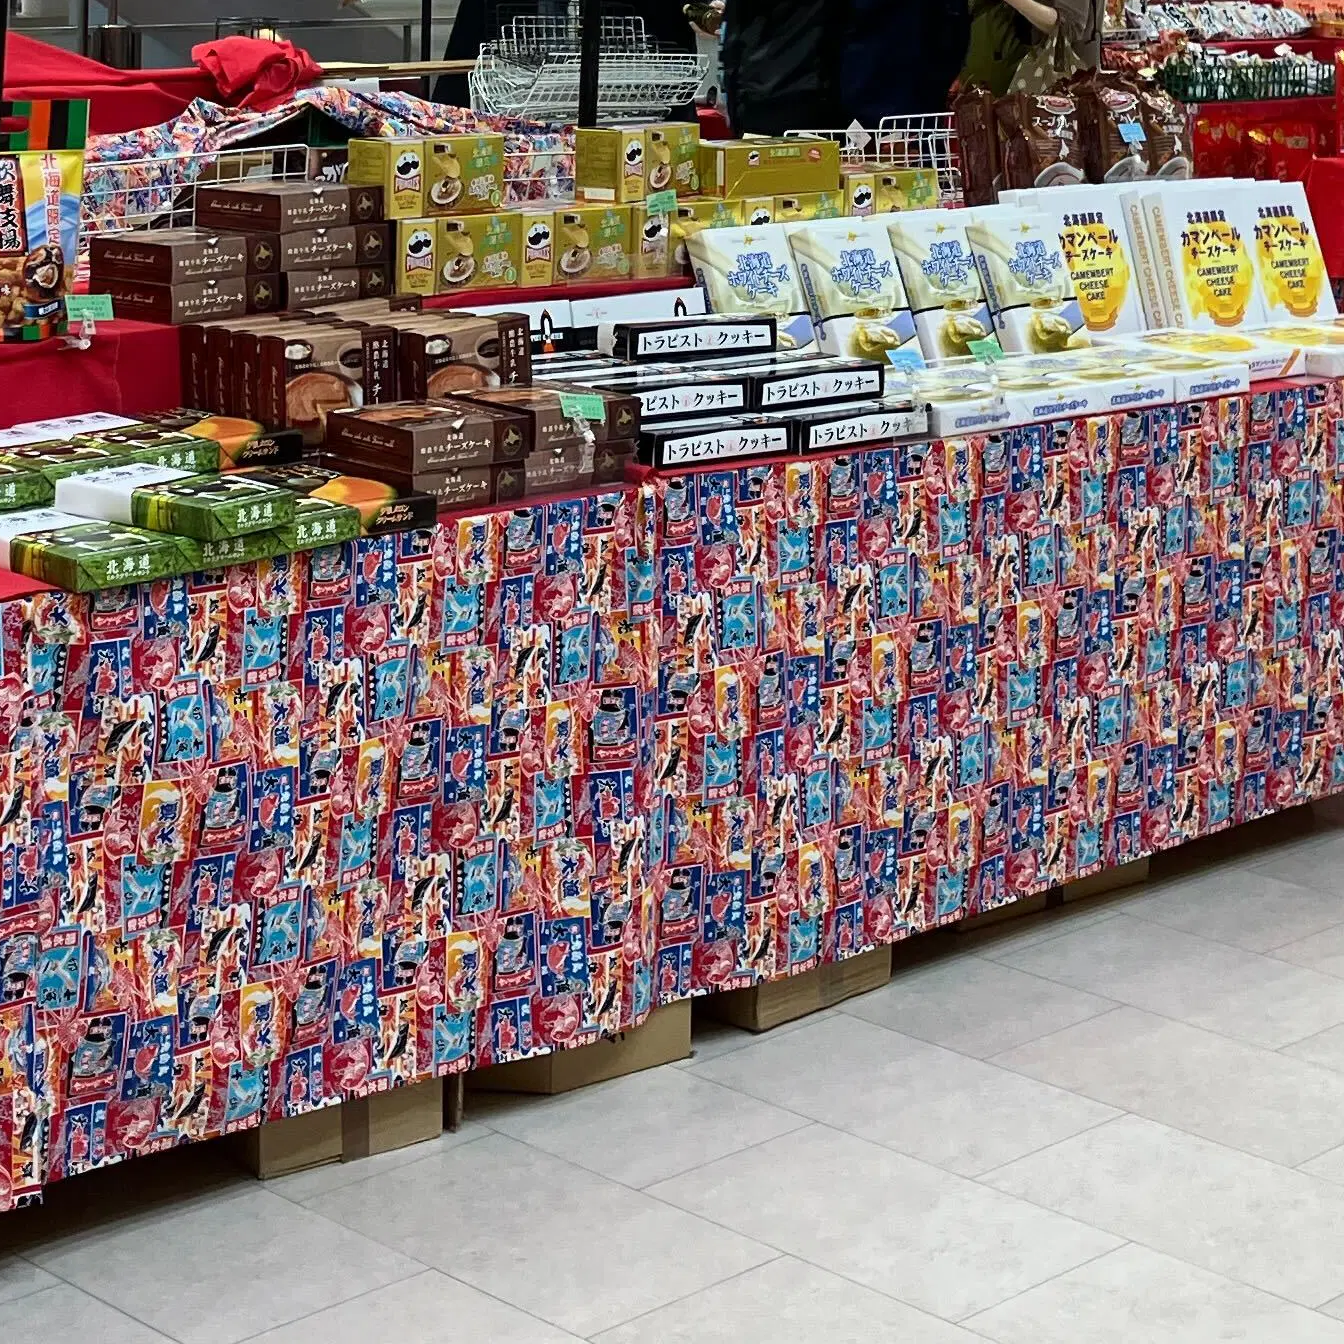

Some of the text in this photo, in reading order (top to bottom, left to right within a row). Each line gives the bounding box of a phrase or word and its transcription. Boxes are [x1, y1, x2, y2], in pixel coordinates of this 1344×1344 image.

[1180, 225, 1241, 247] カマンベール
[1253, 221, 1310, 240] カマンベール
[1058, 228, 1119, 250] カマンベール
[1263, 239, 1307, 253] チーズケーキ
[1065, 247, 1113, 262] チーズケーキ
[1191, 245, 1237, 260] チーズケーキ
[1196, 263, 1239, 277] CAMEMBERT
[1270, 257, 1310, 270] CAMEMBERT
[1070, 266, 1114, 280] CAMEMBERT
[1279, 268, 1308, 279] CHEESE
[1079, 279, 1110, 291] CHEESE
[1206, 276, 1235, 288] CHEESE
[1287, 278, 1306, 289] CAKE
[1086, 290, 1105, 302] CAKE
[1213, 287, 1233, 297] CAKE
[641, 331, 766, 351] トラピスト クッキー
[766, 377, 875, 402] トラピスト クッキー
[693, 391, 738, 407] クッキー
[813, 423, 868, 444] トラピスト
[667, 434, 782, 457] トラピスト クッキー
[237, 501, 274, 523] 北海道
[296, 517, 337, 539] 北海道
[202, 537, 245, 557] 北海道
[106, 553, 152, 575] 北海道
